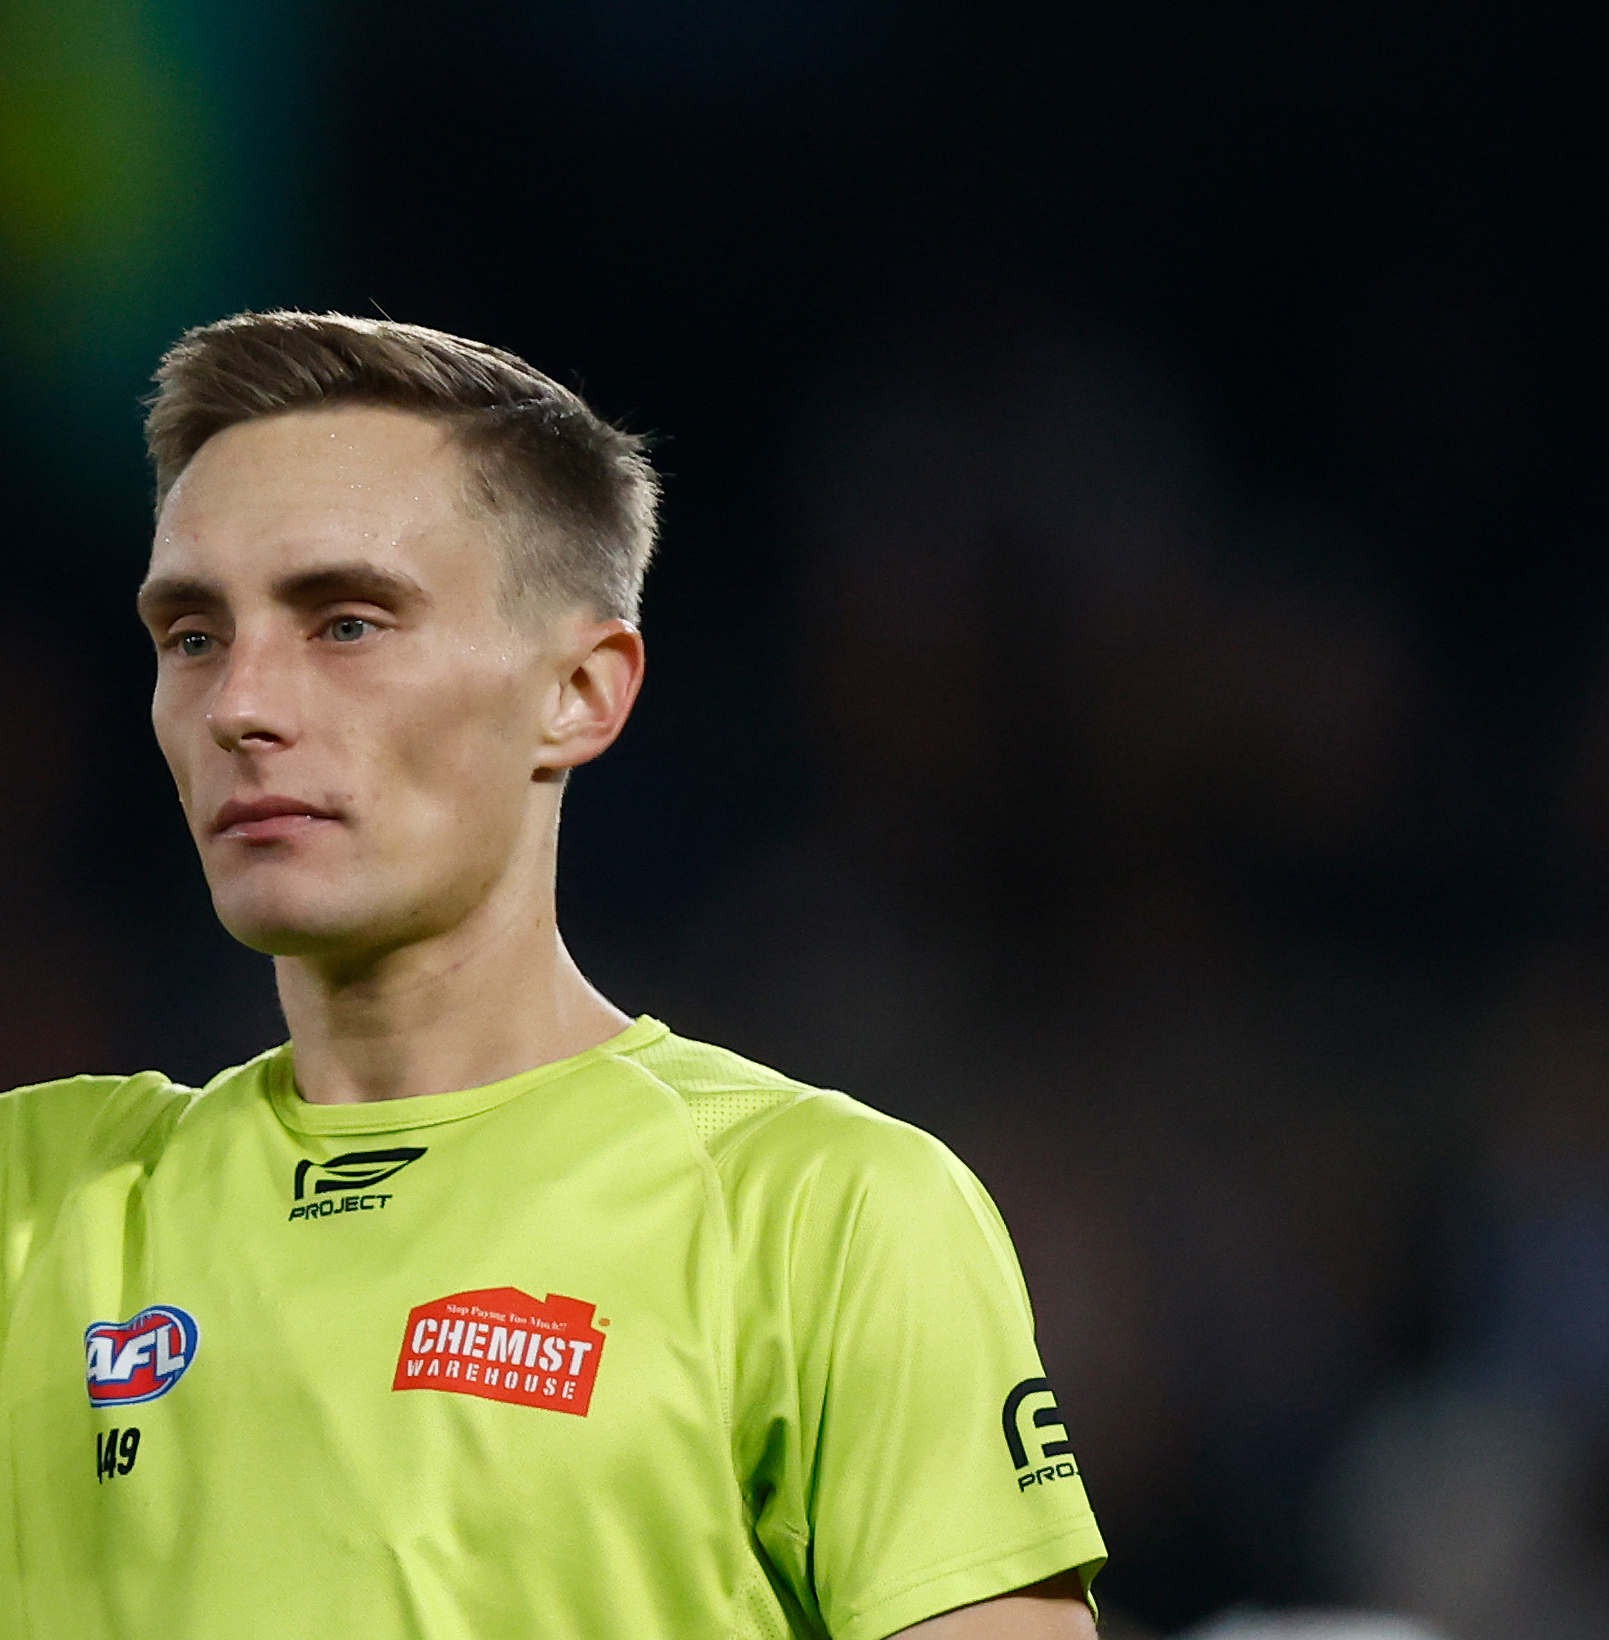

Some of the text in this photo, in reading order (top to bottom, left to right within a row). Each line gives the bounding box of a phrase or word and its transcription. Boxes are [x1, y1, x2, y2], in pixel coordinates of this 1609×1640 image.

[288, 1194, 394, 1222] PROJECT
[86, 1322, 186, 1382] AFL
[411, 1318, 593, 1377] CHEMIST
[406, 1358, 577, 1401] WAREHOUSE
[1017, 1461, 1080, 1493] PRO
